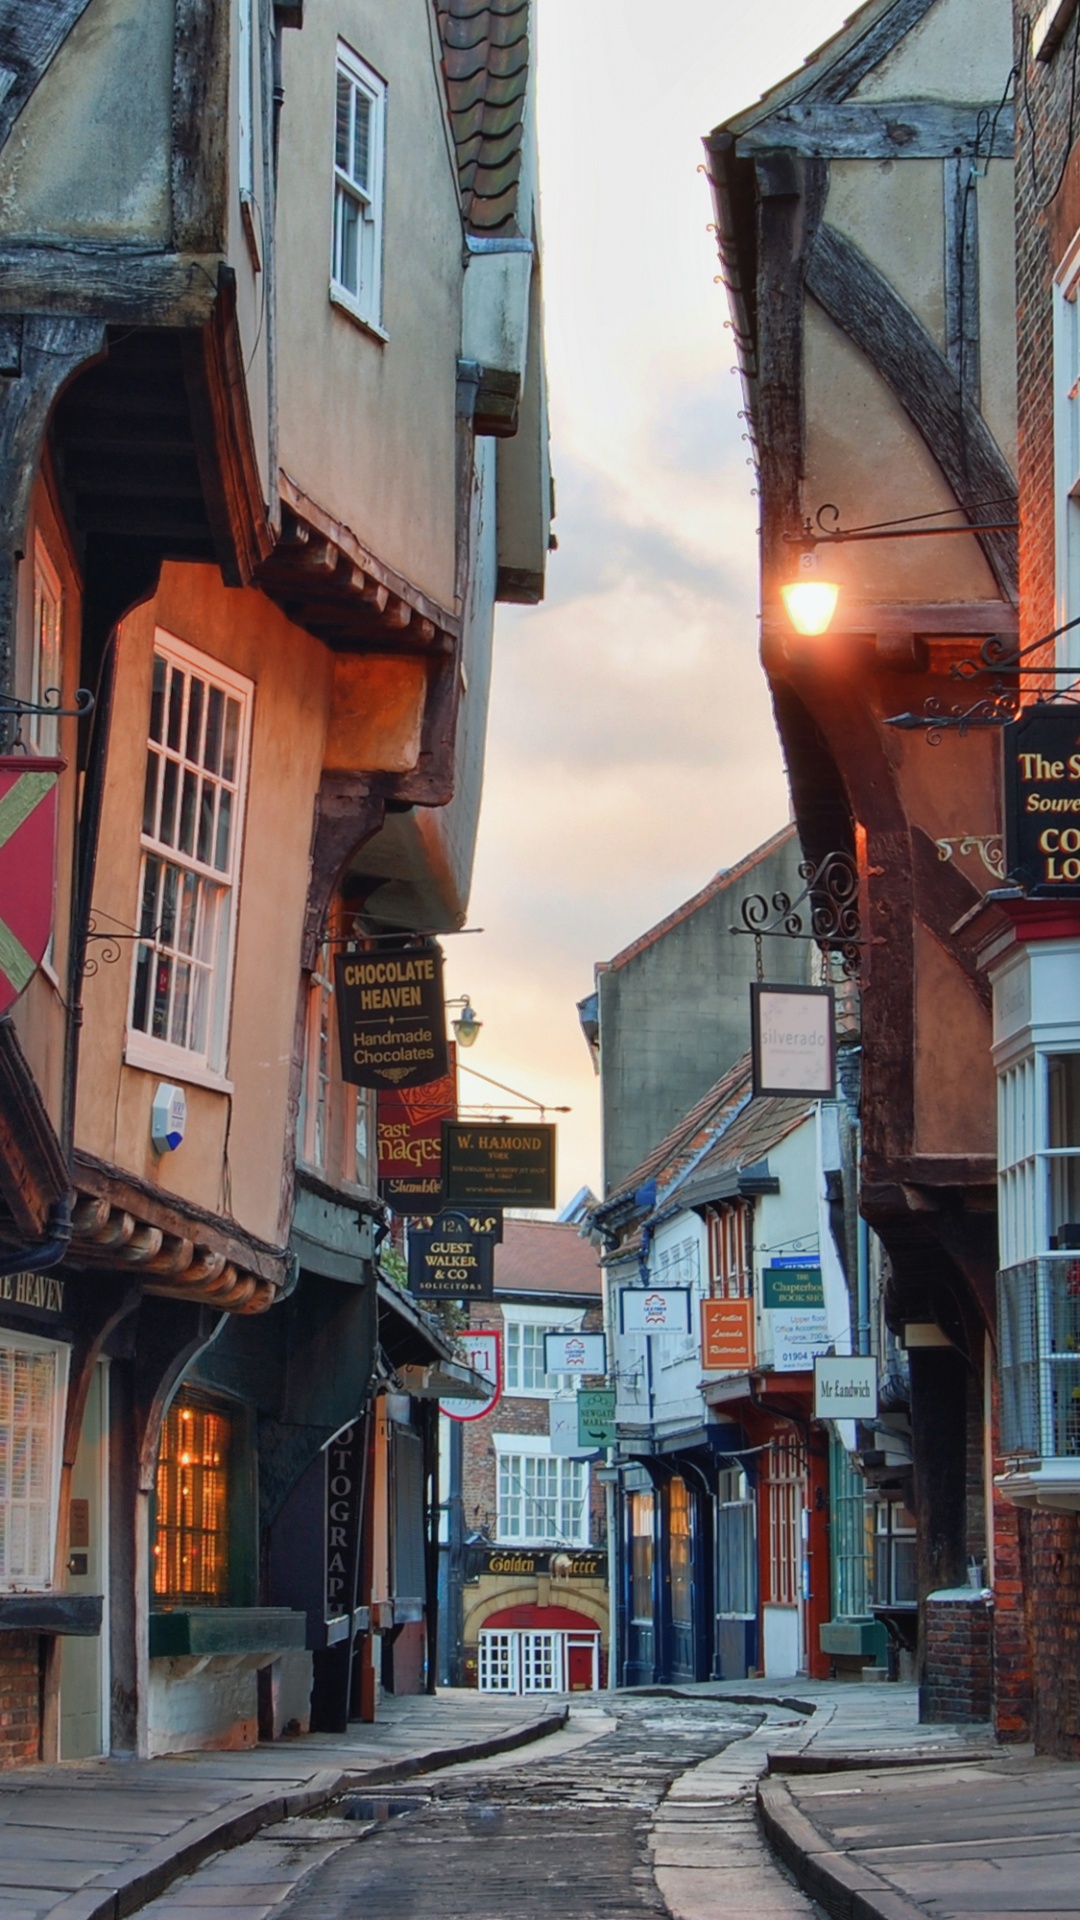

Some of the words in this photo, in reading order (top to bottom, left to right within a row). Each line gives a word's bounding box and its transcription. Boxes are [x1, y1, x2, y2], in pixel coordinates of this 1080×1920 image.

[1018, 753, 1063, 779] The
[344, 959, 435, 986] CHOCOLATE
[361, 986, 422, 1010] HEAVEN
[353, 1028, 432, 1047] Handmade
[762, 1029, 826, 1047] silverado
[353, 1047, 434, 1065] Chocolates
[457, 1134, 474, 1149] W.
[478, 1136, 542, 1150] HAMOND
[488, 1151, 509, 1160] YORK
[430, 1242, 473, 1253] GUEST
[425, 1255, 478, 1267] WALKER
[434, 1269, 445, 1280] &
[447, 1269, 468, 1280] CO
[15, 1272, 65, 1313] HEAVEN
[420, 1282, 482, 1290] SOLICITORS
[779, 1294, 804, 1302] BOOK
[790, 1316, 811, 1324] Upper
[775, 1325, 794, 1333] Office
[782, 1352, 808, 1361] 01904
[821, 1380, 832, 1398] Mr
[489, 1557, 535, 1572] Golden
